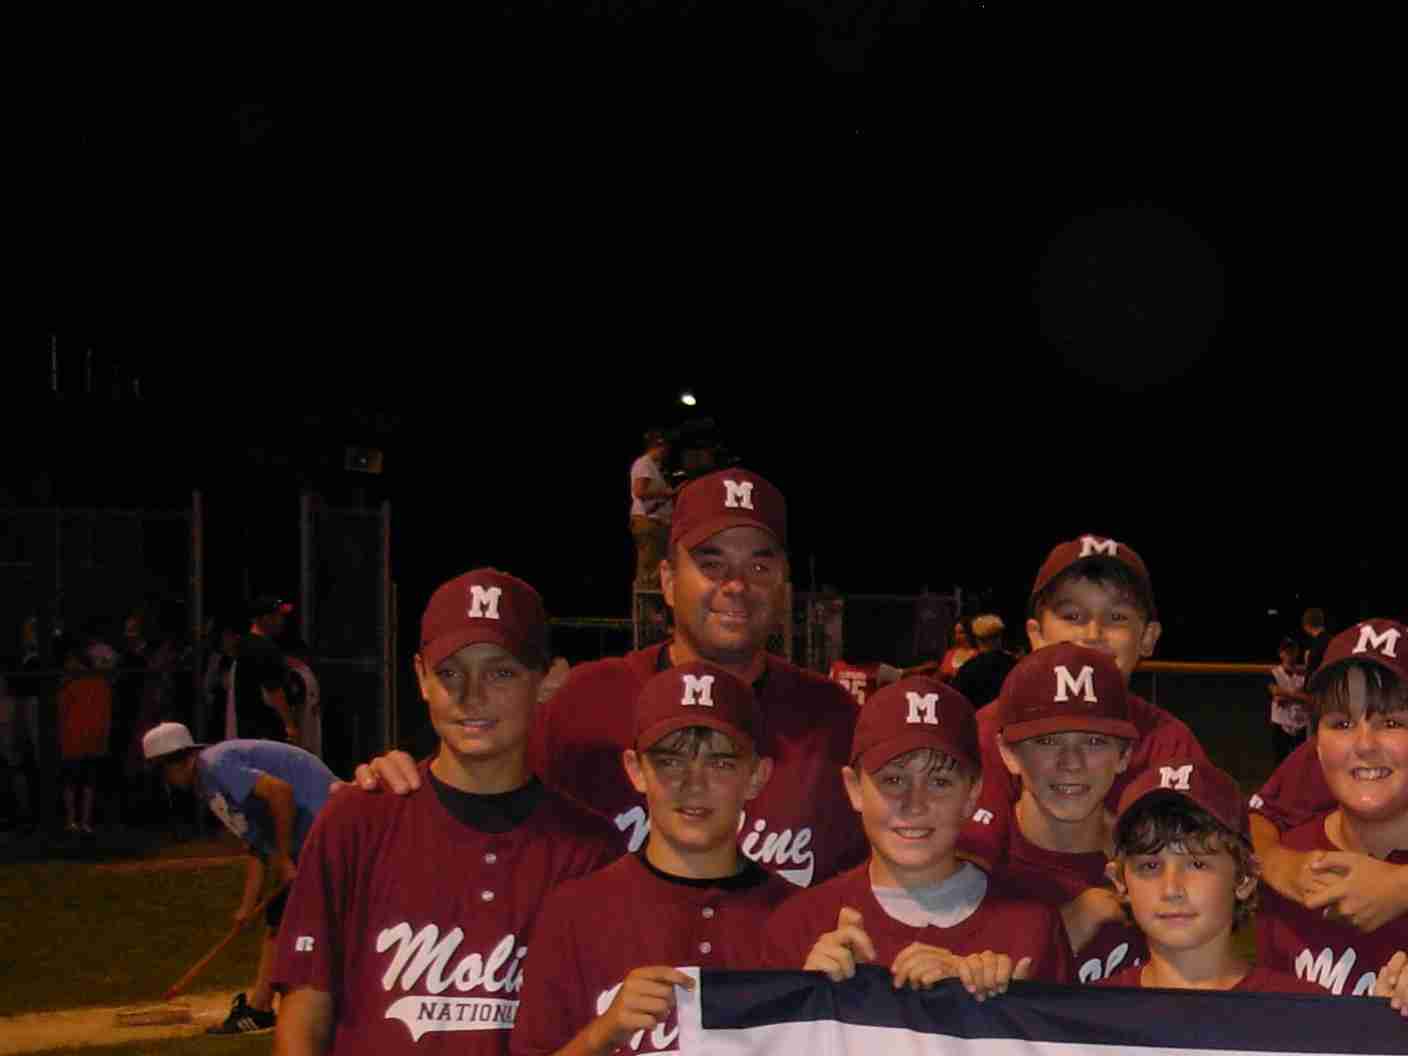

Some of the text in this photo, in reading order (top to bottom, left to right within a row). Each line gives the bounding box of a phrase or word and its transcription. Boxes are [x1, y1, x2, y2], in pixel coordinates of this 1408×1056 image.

[724, 480, 754, 510] M
[1080, 536, 1118, 557] M
[469, 585, 501, 619] M
[1352, 625, 1400, 658] M
[682, 674, 714, 707] M
[1054, 665, 1097, 703] M
[906, 691, 938, 724] M
[1160, 765, 1192, 790] M
[376, 922, 527, 994] Moli
